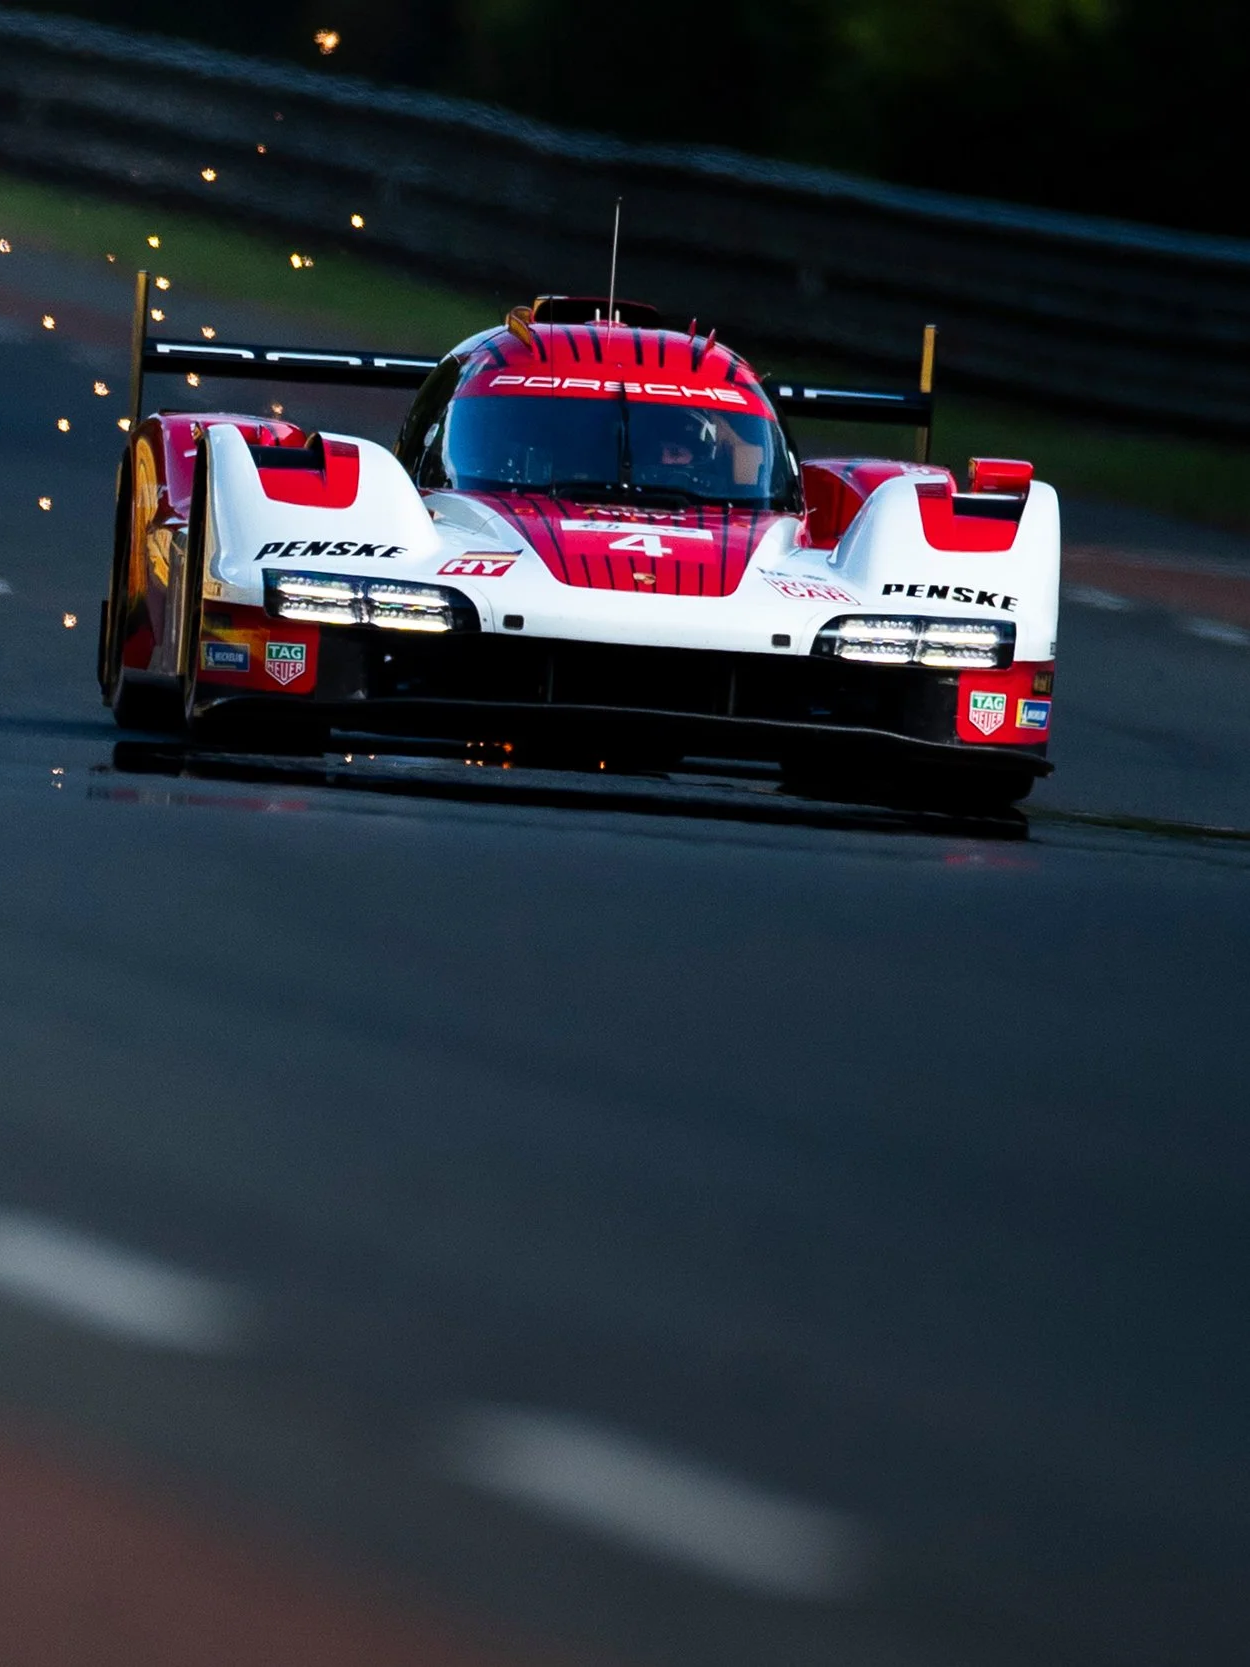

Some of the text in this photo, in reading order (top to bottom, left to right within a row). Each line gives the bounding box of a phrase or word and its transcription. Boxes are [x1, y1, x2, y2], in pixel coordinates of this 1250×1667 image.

[489, 375, 748, 405] PORSCHE
[253, 540, 407, 561] PENSKE
[608, 534, 673, 558] 4
[442, 560, 512, 575] HY
[881, 583, 1019, 613] PENSKE
[268, 645, 302, 660] TAG
[267, 661, 303, 682] HEUER
[973, 695, 1004, 710] TAG
[971, 710, 1003, 732] HEUER
